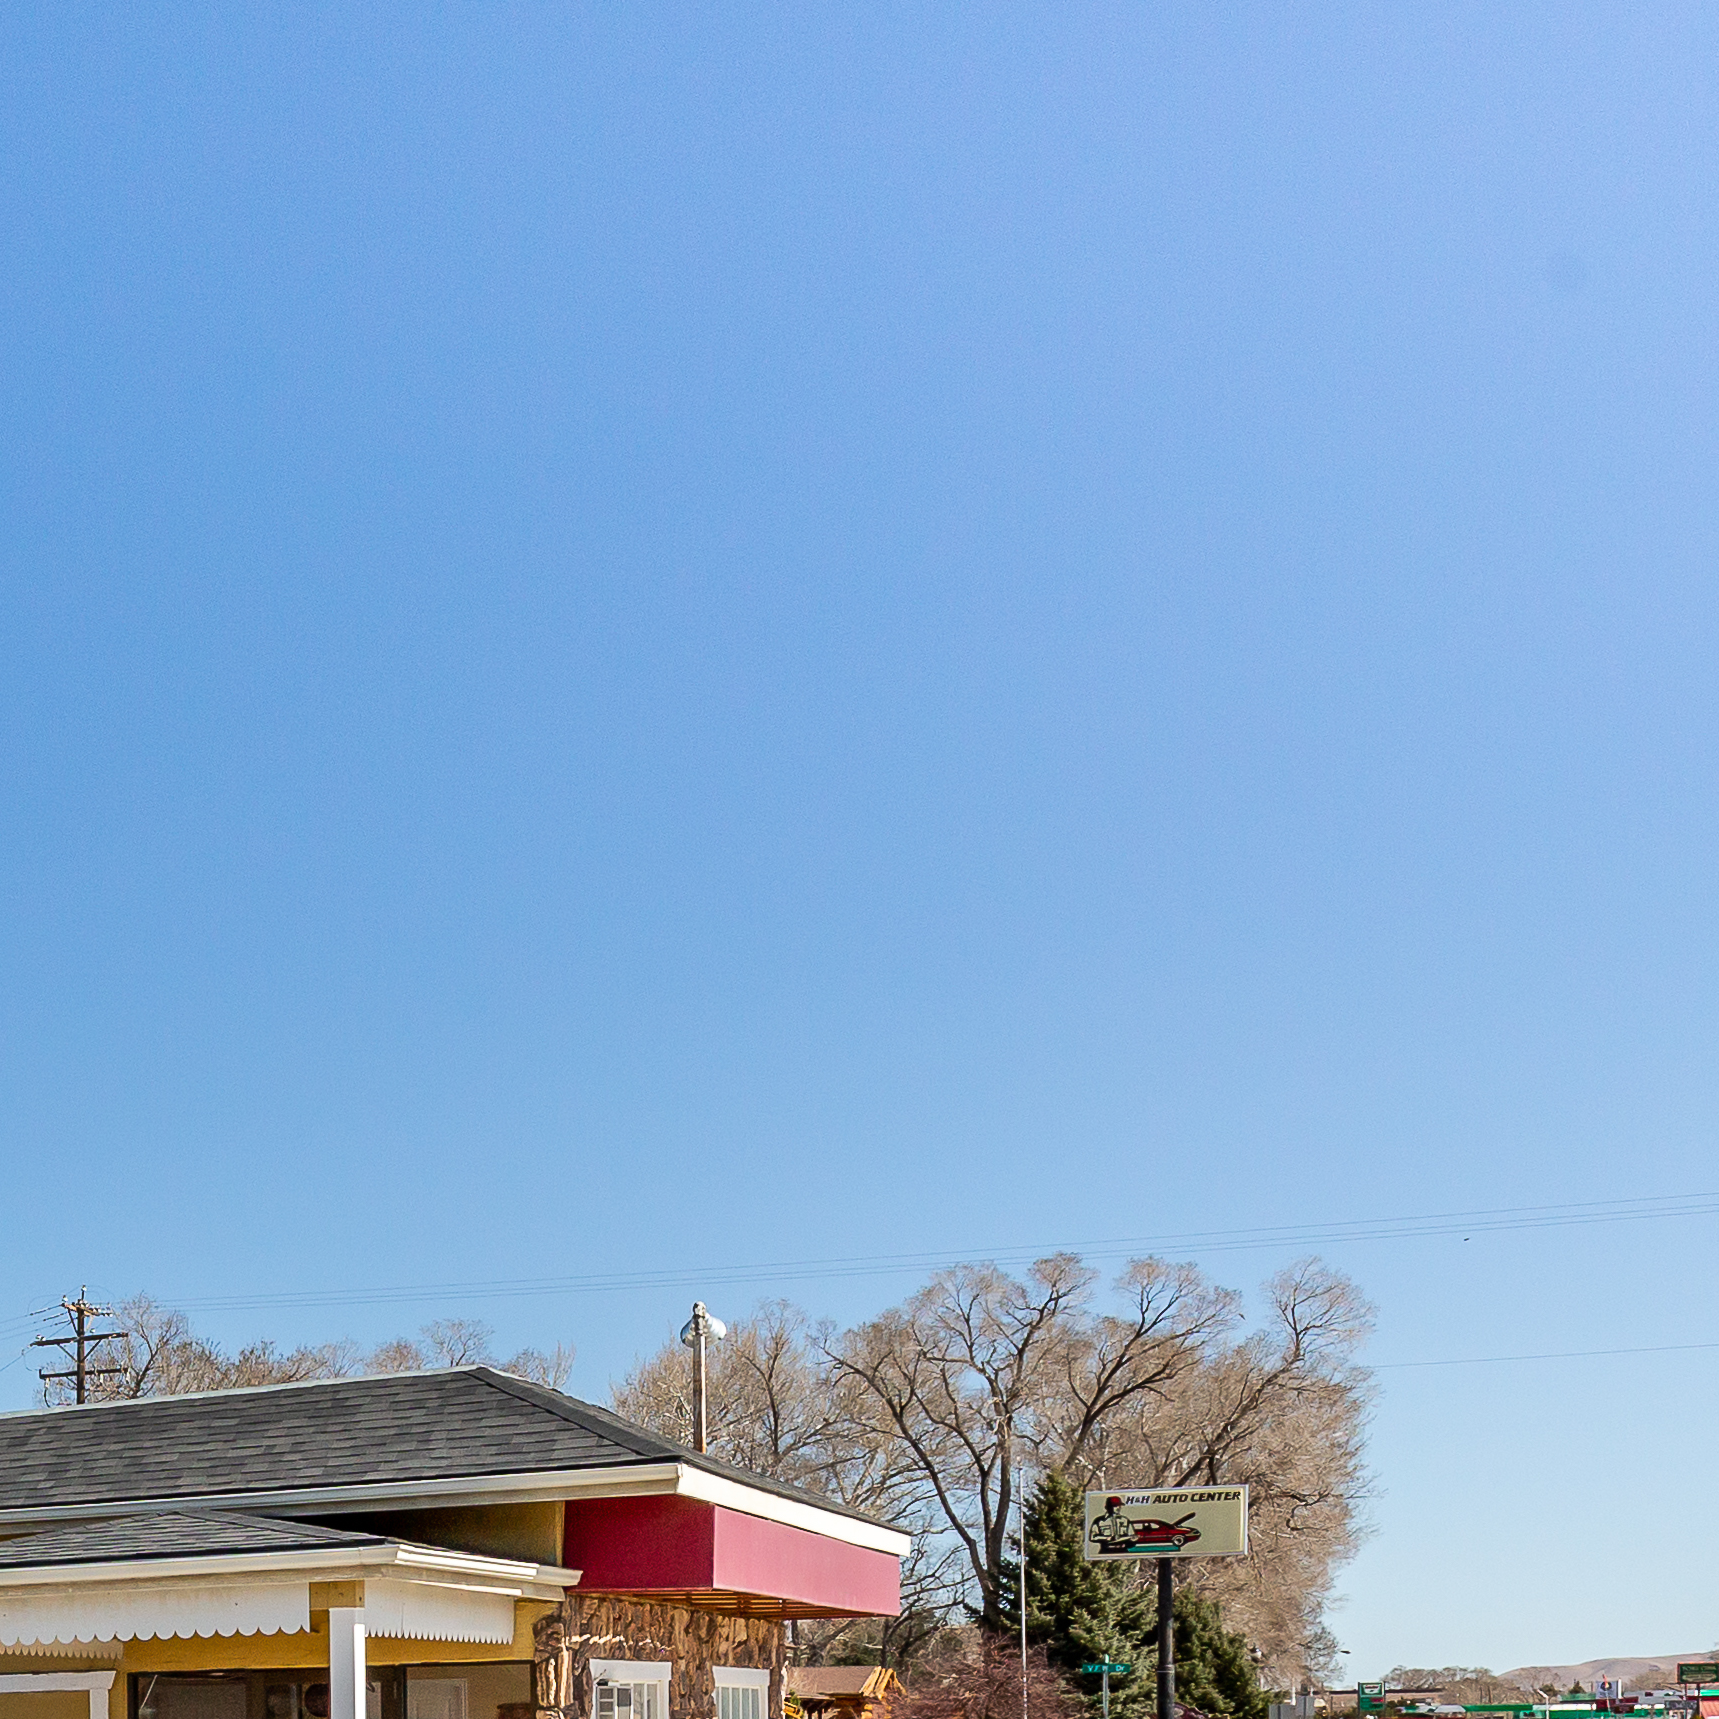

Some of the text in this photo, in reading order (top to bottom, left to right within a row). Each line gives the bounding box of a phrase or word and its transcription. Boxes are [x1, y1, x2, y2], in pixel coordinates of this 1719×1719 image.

[1125, 1491, 1242, 1505] H&H AUTO CENTER
